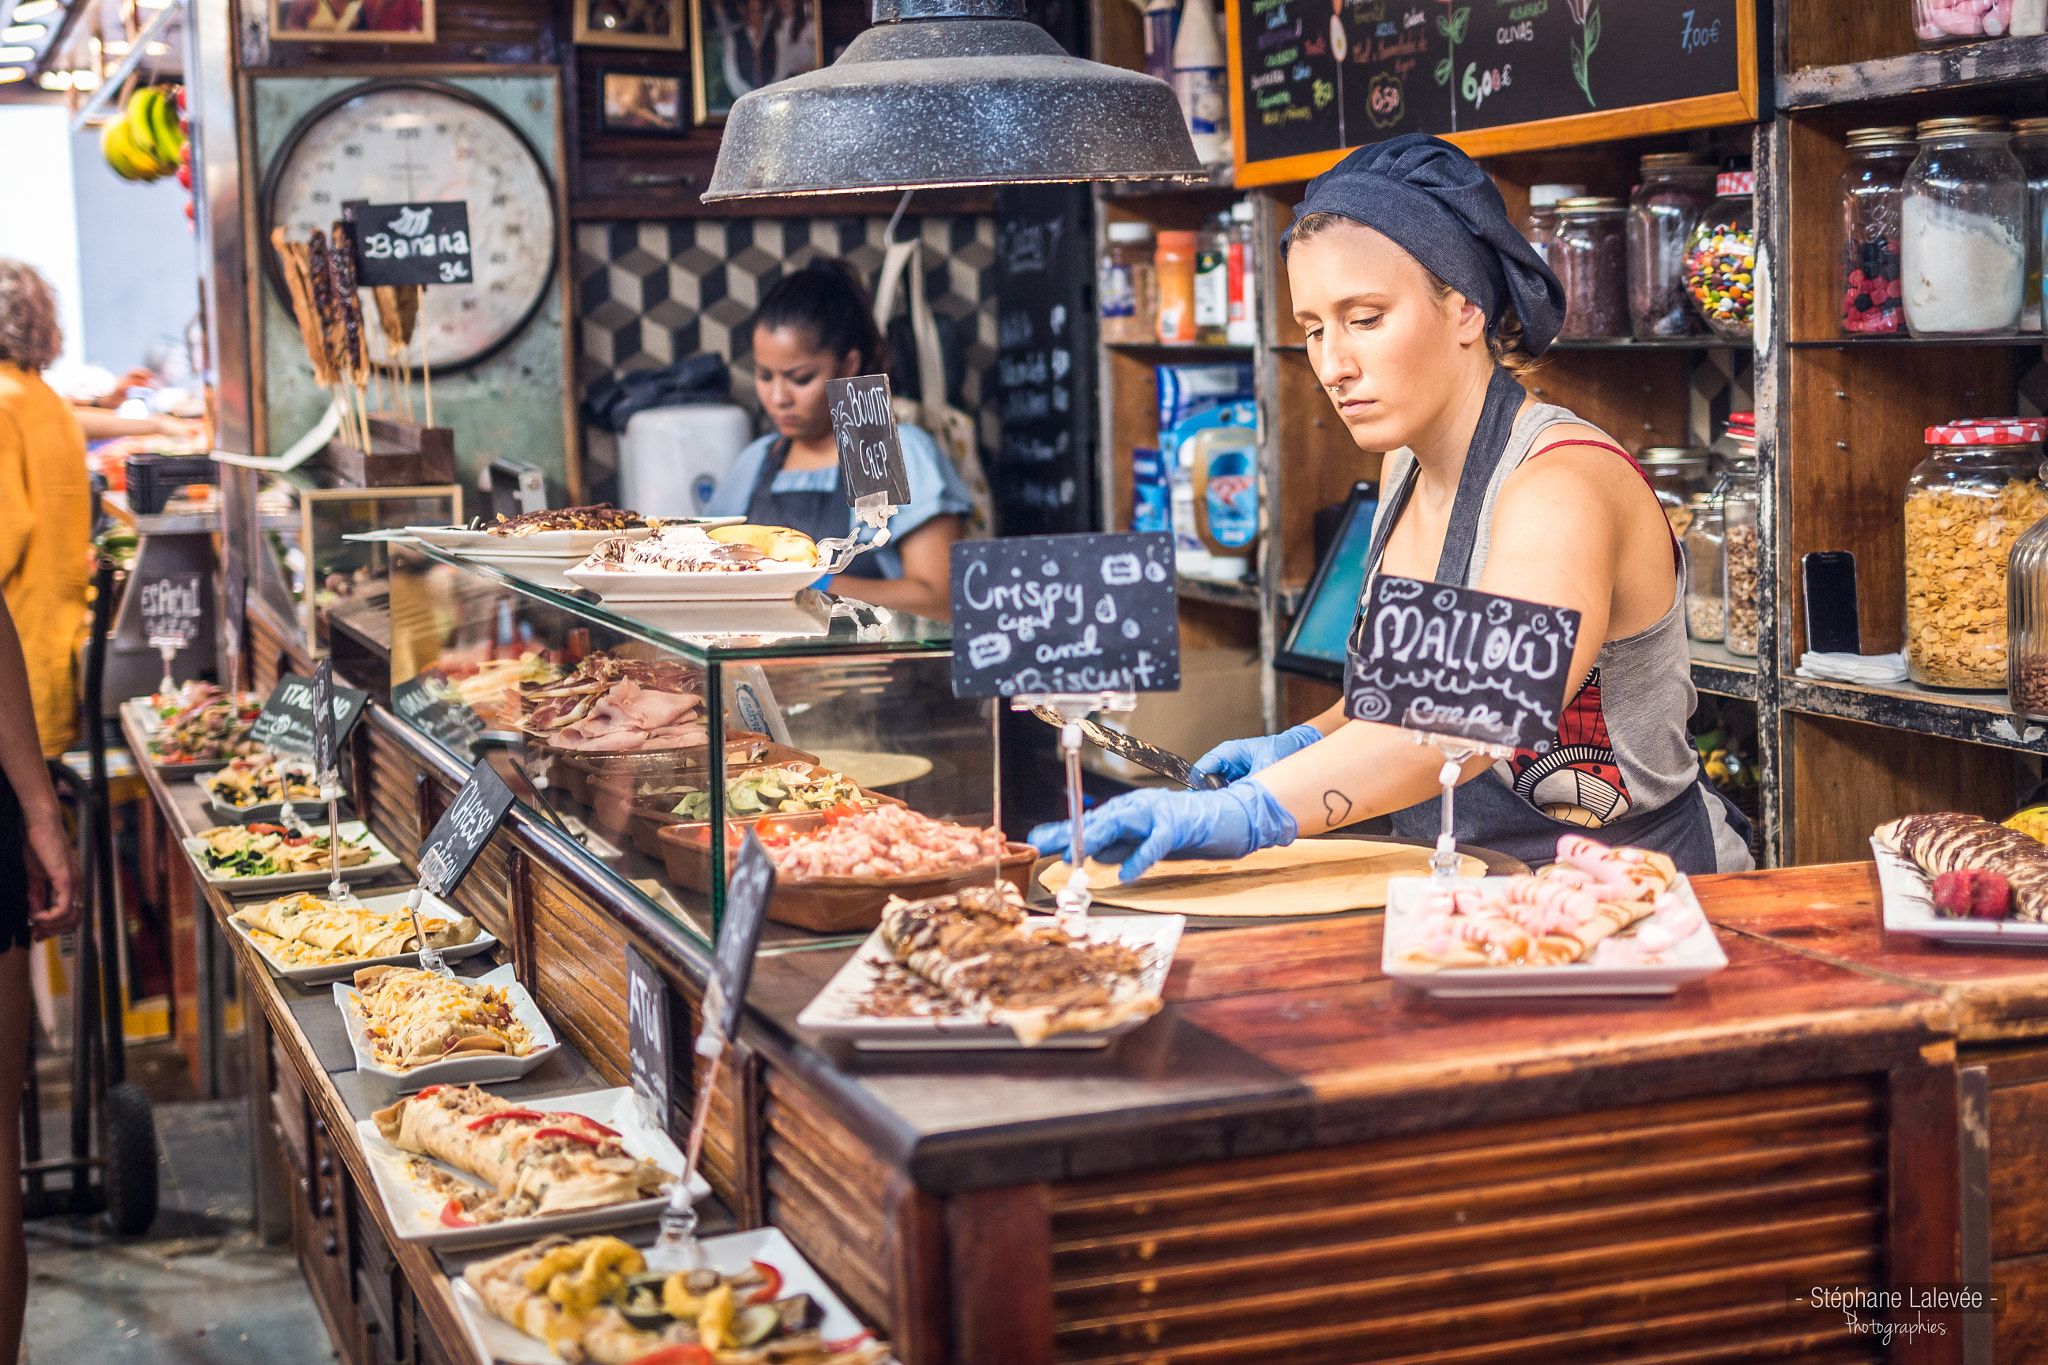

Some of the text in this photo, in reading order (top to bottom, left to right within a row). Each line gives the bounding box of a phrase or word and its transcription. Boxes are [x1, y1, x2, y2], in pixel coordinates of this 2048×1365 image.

[1496, 20, 1534, 45] OLIVAS
[1681, 9, 1721, 54] 7,00€
[1462, 61, 1512, 111] 6,00€
[364, 230, 470, 259] Banana
[846, 381, 892, 440] BOUNTY
[860, 439, 888, 480] CREP
[963, 559, 1084, 625] Crispy
[1035, 623, 1103, 664] and
[1369, 603, 1560, 681] MALLOW
[281, 683, 352, 721] ITALNO
